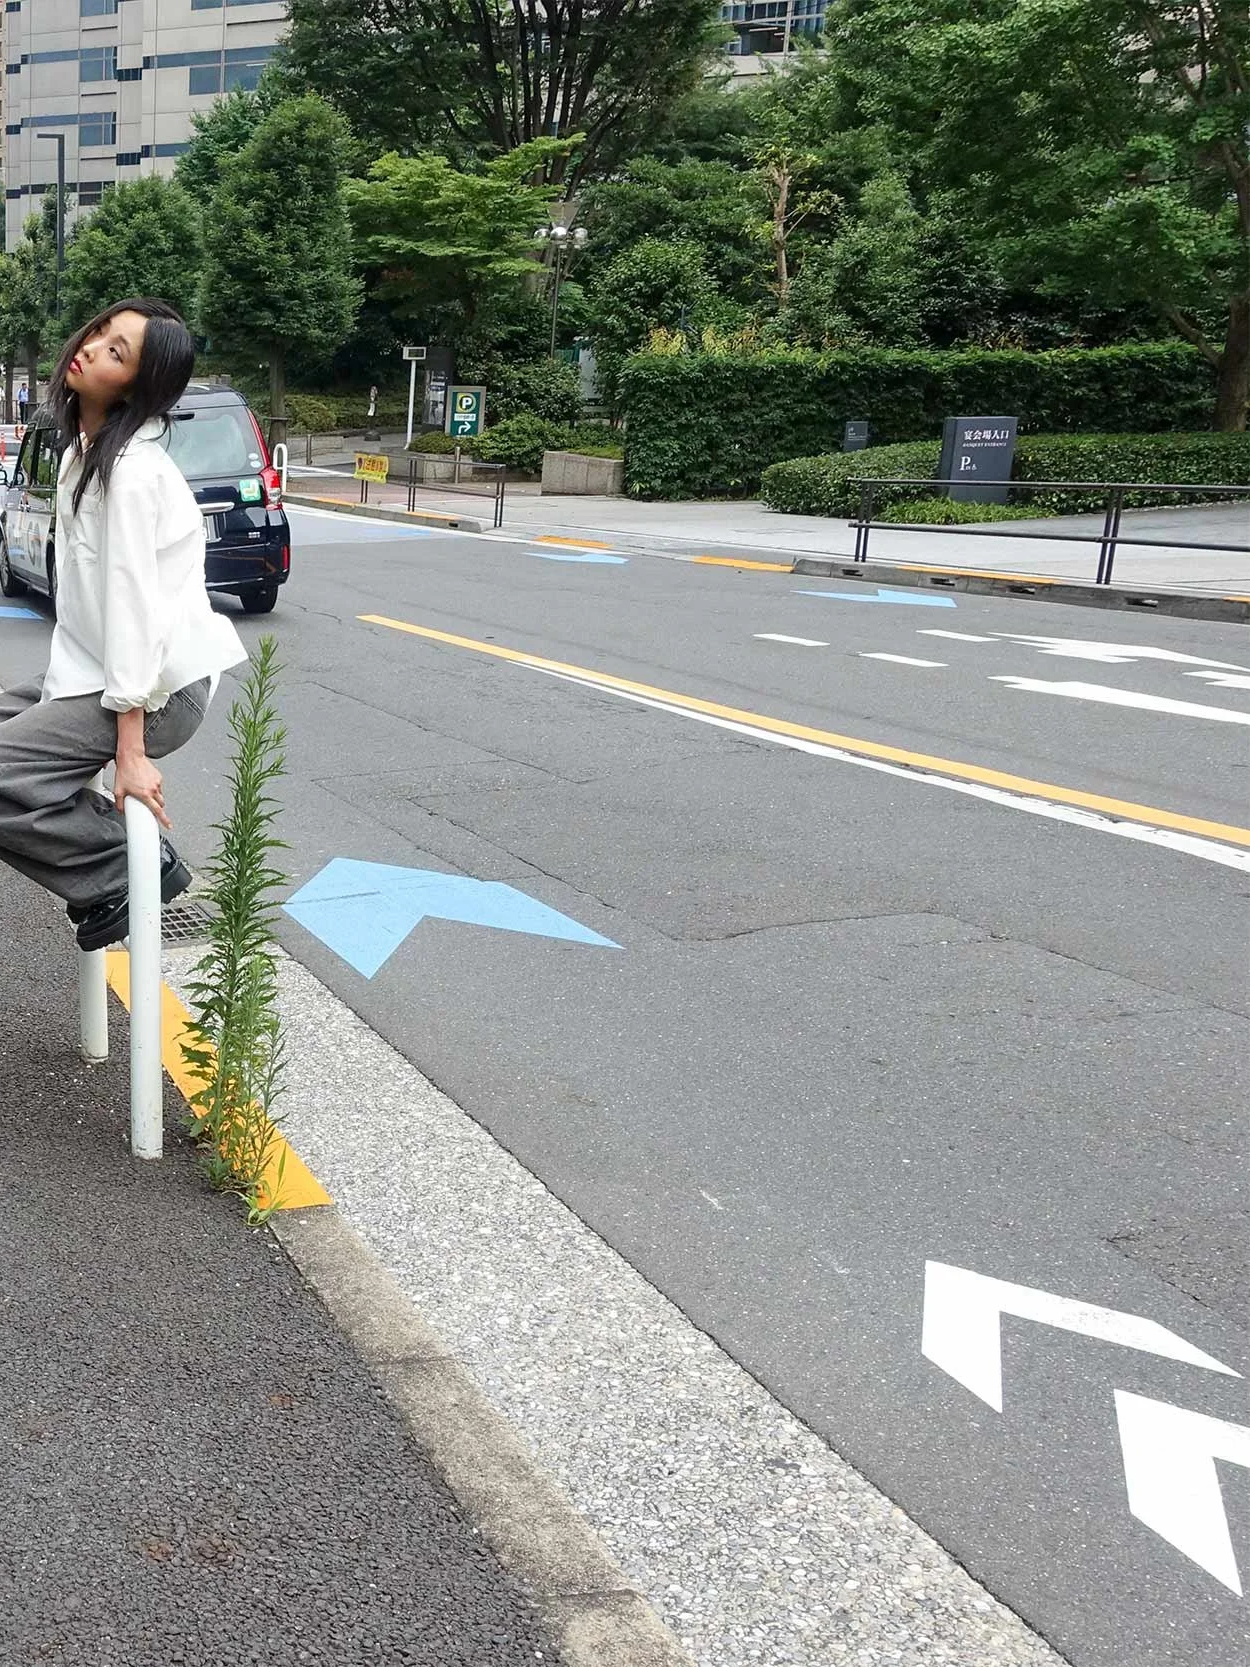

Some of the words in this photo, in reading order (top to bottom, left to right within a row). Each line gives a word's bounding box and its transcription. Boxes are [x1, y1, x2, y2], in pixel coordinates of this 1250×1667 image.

[461, 397, 473, 409] P
[964, 429, 1010, 441] 宴会場入口
[959, 456, 971, 471] P
